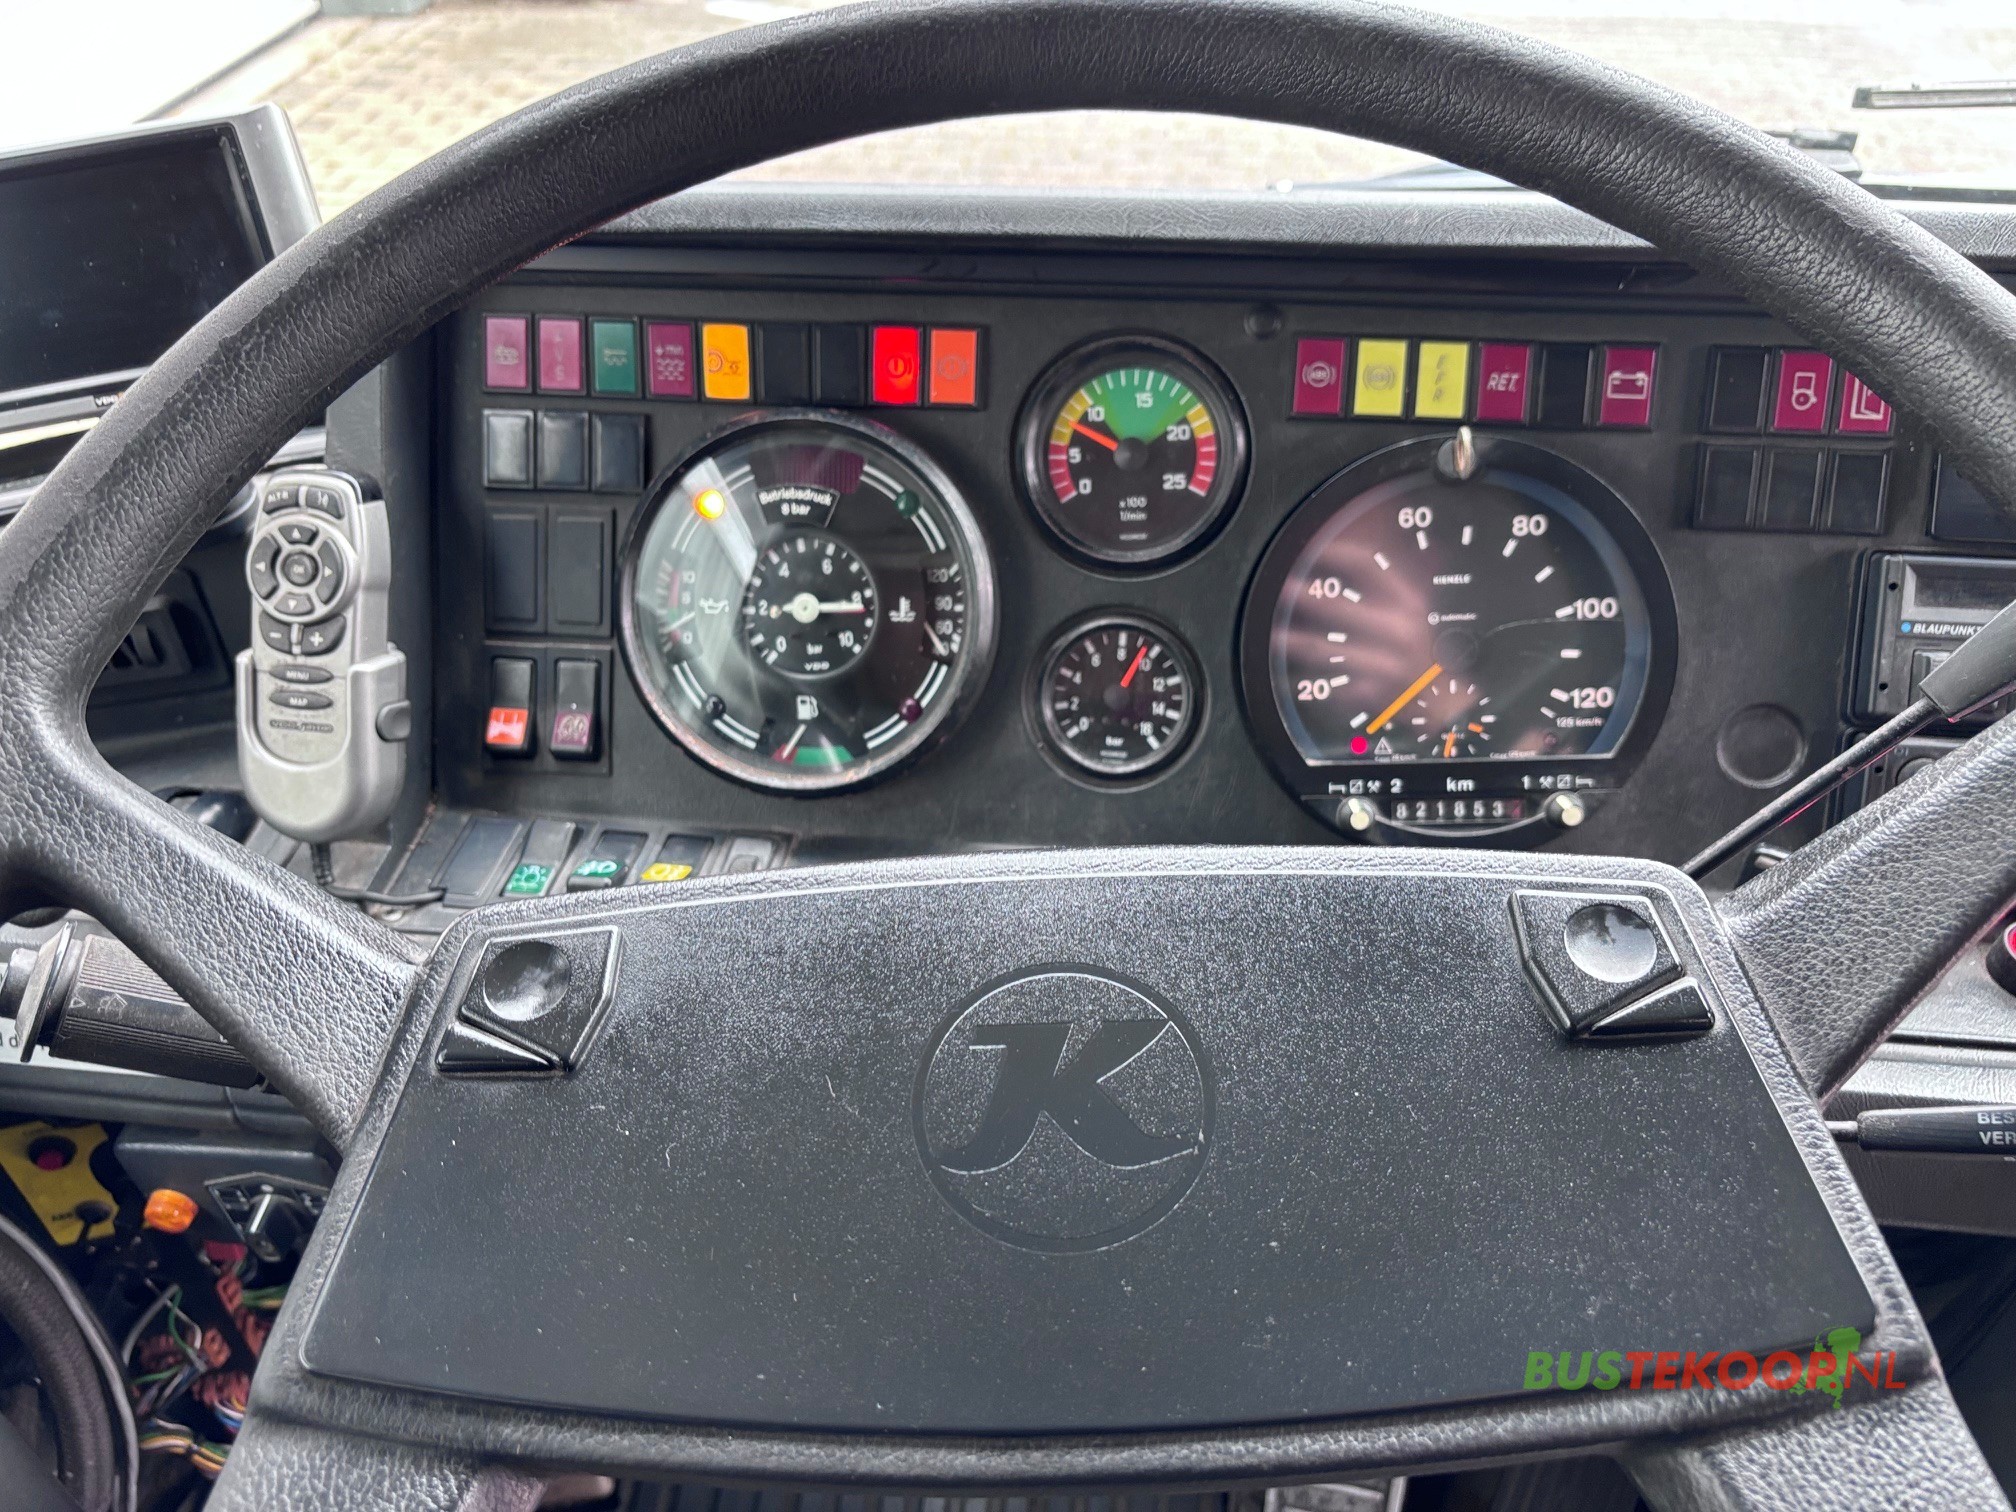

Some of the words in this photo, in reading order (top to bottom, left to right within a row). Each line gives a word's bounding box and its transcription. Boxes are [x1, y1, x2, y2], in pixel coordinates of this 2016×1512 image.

[1136, 391, 1154, 408] 15
[1087, 406, 1105, 422] 10
[1167, 425, 1191, 441] 20
[1068, 448, 1082, 464] 5
[1078, 478, 1092, 494] 0
[1162, 474, 1187, 490] 25
[791, 502, 812, 516] bar
[1398, 506, 1433, 529] 60
[1511, 513, 1549, 537] 80
[779, 561, 790, 578] 4
[822, 557, 833, 575] 6
[1308, 576, 1342, 599] 40
[758, 599, 769, 616] 2
[1573, 596, 1619, 620] 100
[682, 631, 693, 645] 0
[776, 635, 787, 653] 0
[839, 630, 854, 648] 10
[1091, 652, 1101, 668] 6
[286, 670, 310, 681] MENU
[1072, 671, 1083, 685] 4
[1153, 677, 1167, 692] 12
[1297, 678, 1331, 701] 20
[289, 696, 308, 706] MAP
[1070, 695, 1081, 711] 2
[1569, 687, 1615, 709] 120
[1152, 701, 1166, 716] 14
[1079, 716, 1090, 732] 0
[1390, 777, 1403, 794] 2
[1446, 776, 1476, 793] km
[1521, 774, 1532, 790] 1
